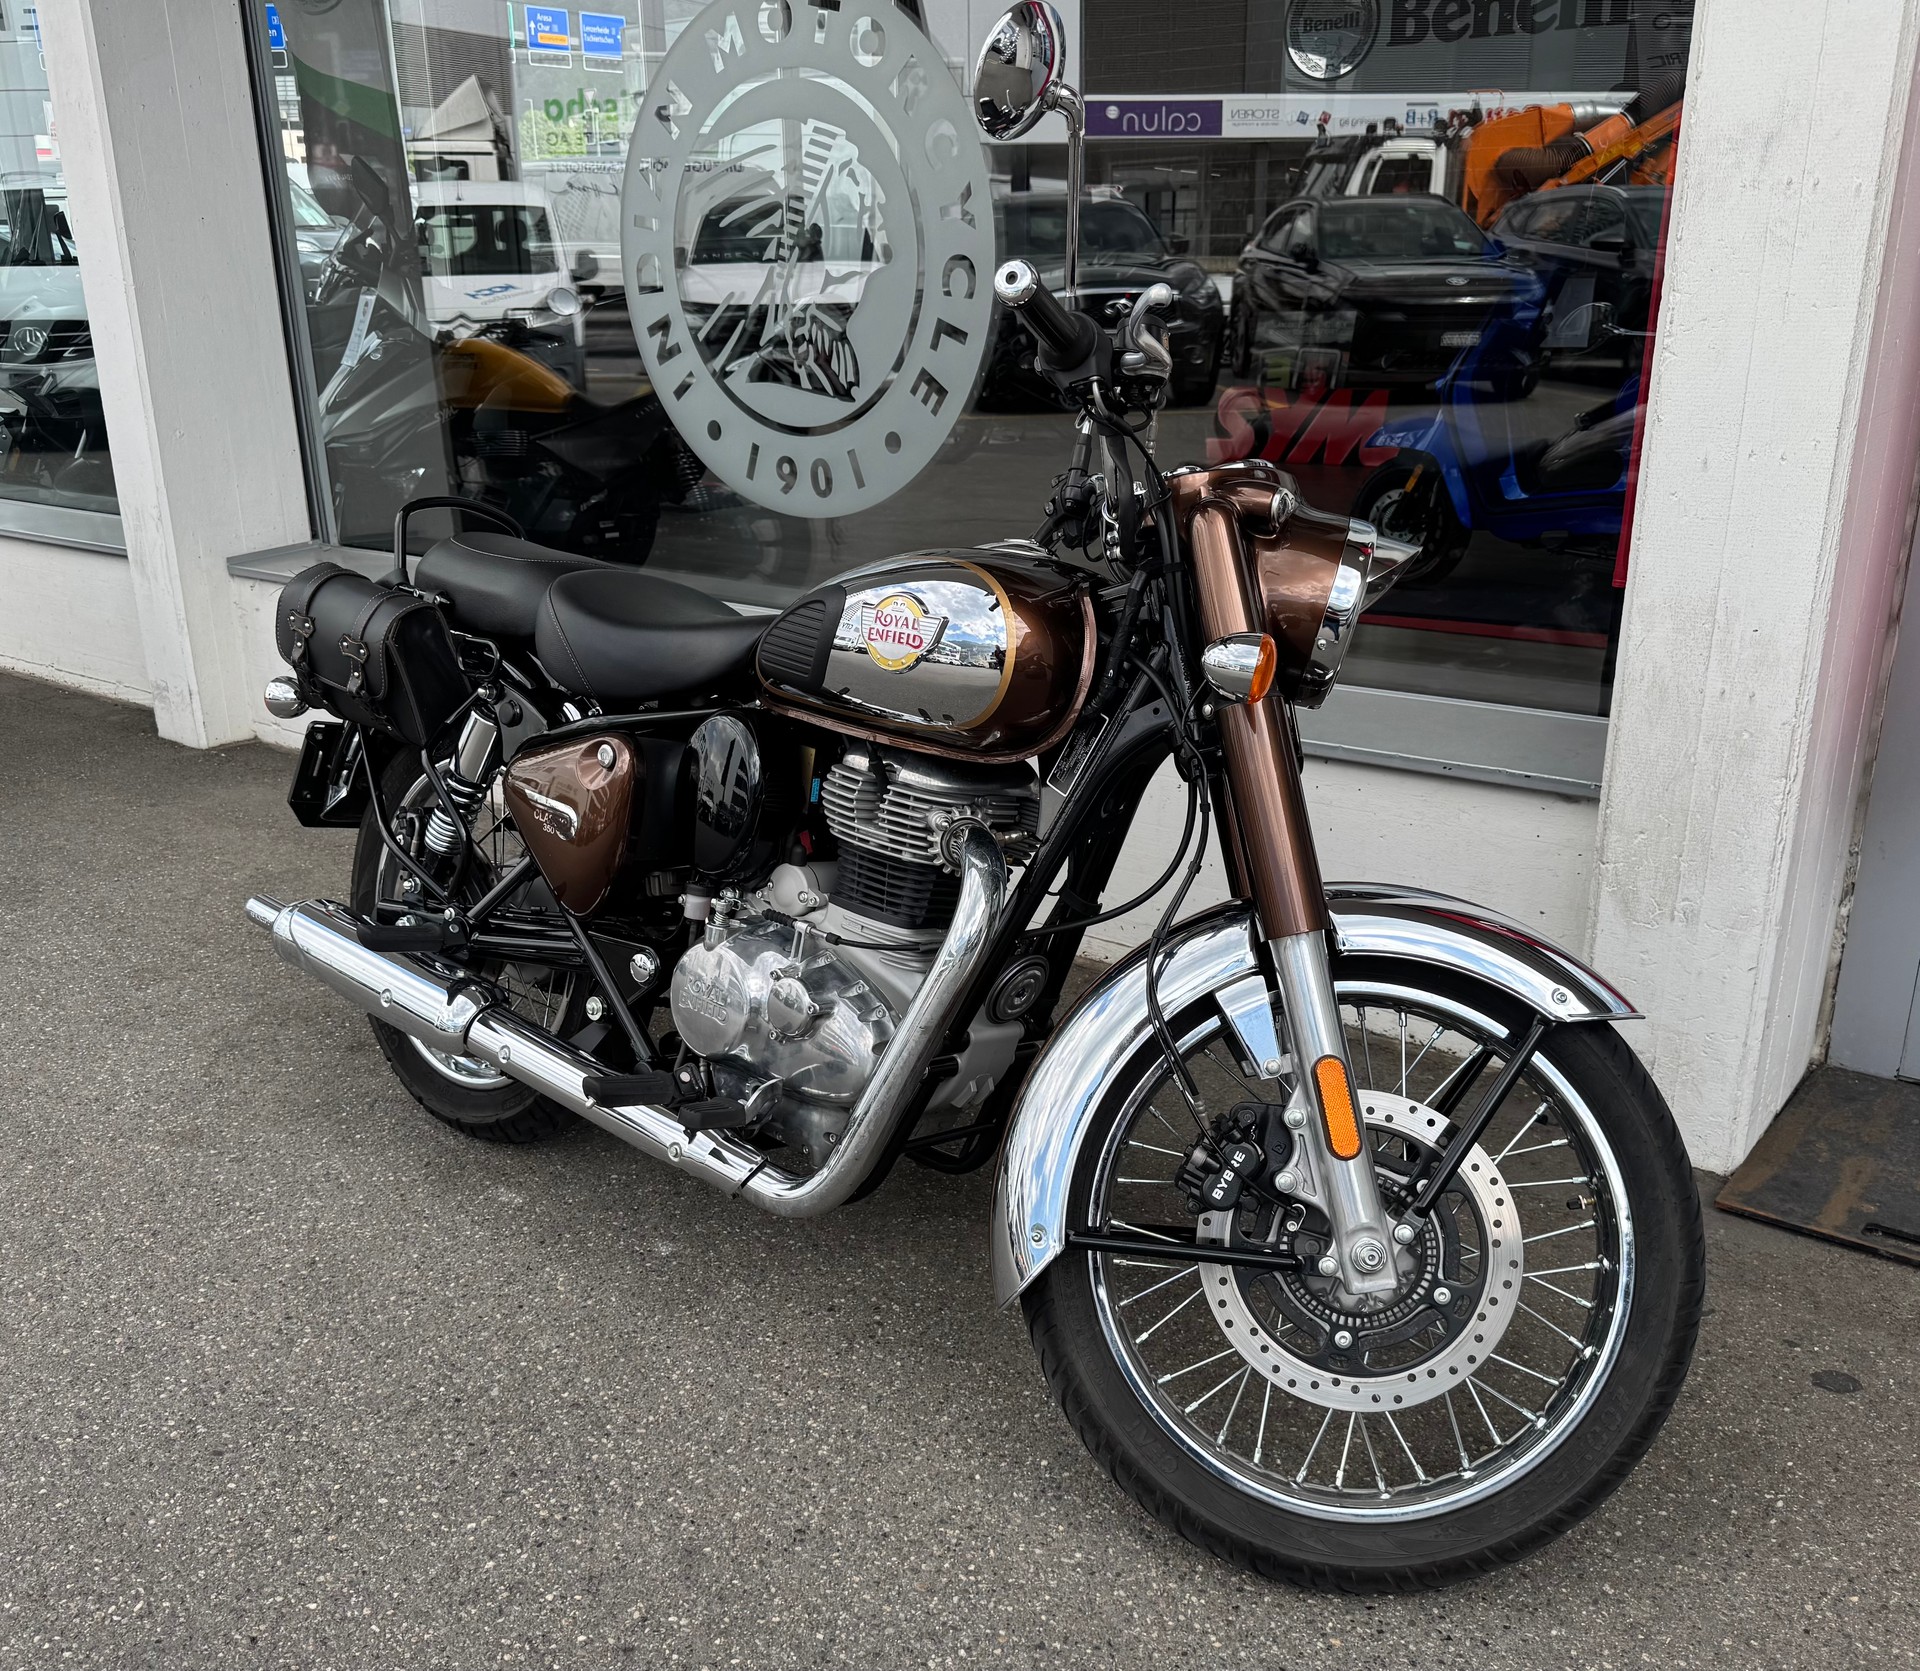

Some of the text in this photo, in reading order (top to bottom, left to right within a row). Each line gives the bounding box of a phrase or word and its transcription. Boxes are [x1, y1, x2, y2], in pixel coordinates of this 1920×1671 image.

[536, 13, 553, 22] Arosa
[1301, 12, 1361, 32] Benelli
[1206, 386, 1399, 467] SYM
[745, 441, 866, 500] 1901
[874, 609, 920, 631] ROYAL
[867, 626, 924, 650] ENFIELD
[542, 823, 555, 835] 350
